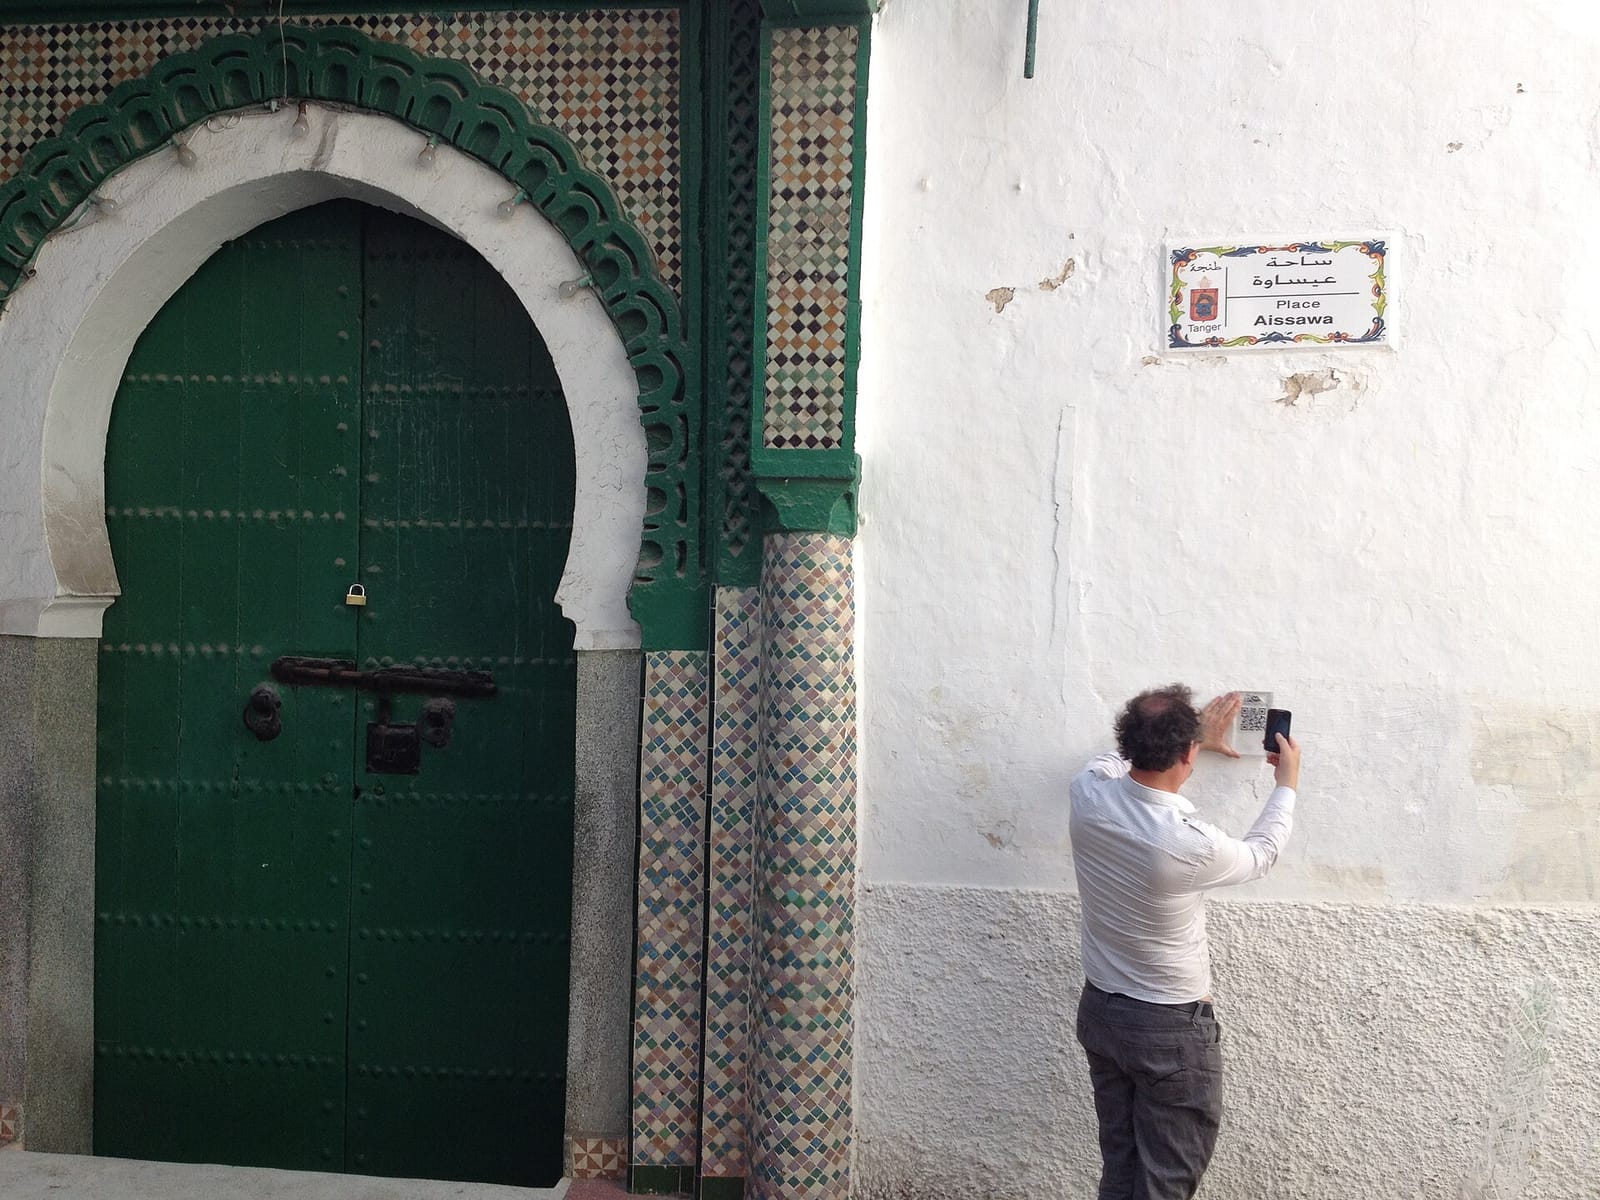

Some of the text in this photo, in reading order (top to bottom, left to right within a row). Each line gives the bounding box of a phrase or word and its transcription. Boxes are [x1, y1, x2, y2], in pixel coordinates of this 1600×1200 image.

[1189, 261, 1222, 272] طنجة
[1265, 255, 1333, 267] ساحة
[1252, 274, 1337, 288] عيساوة
[1276, 299, 1321, 310] Place
[1253, 314, 1334, 326] Aissawa
[1187, 323, 1222, 334] Tanger
